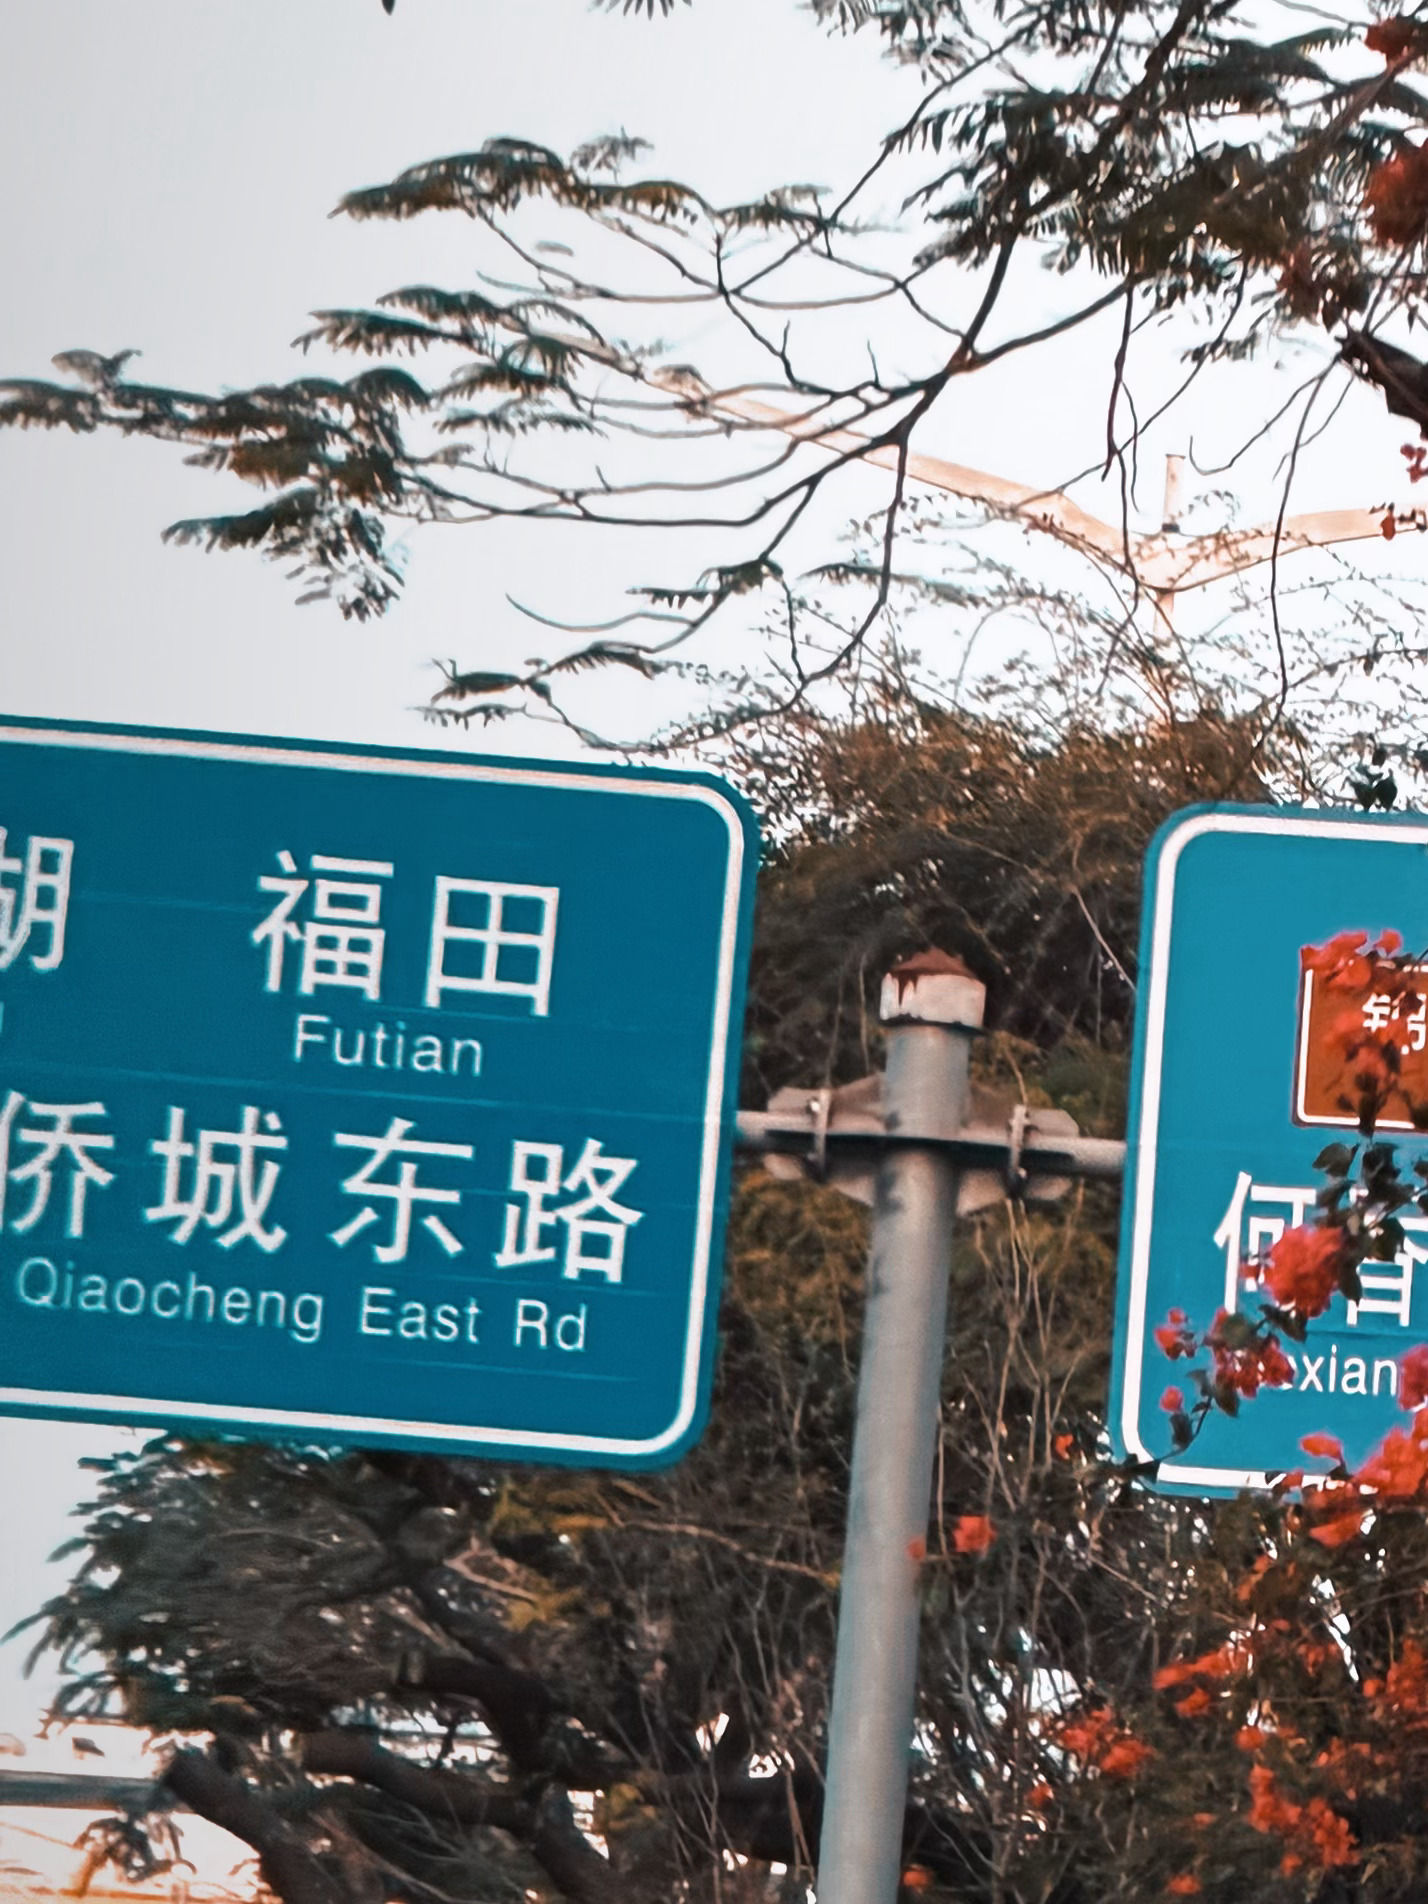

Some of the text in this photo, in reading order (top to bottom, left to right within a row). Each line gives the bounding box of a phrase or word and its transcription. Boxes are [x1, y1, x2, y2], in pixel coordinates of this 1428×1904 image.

[252, 849, 560, 1016] 福田
[293, 1013, 482, 1075] Futian
[0, 1090, 644, 1284] 侨城东路
[17, 1256, 586, 1351] Qiaocheng East Rd
